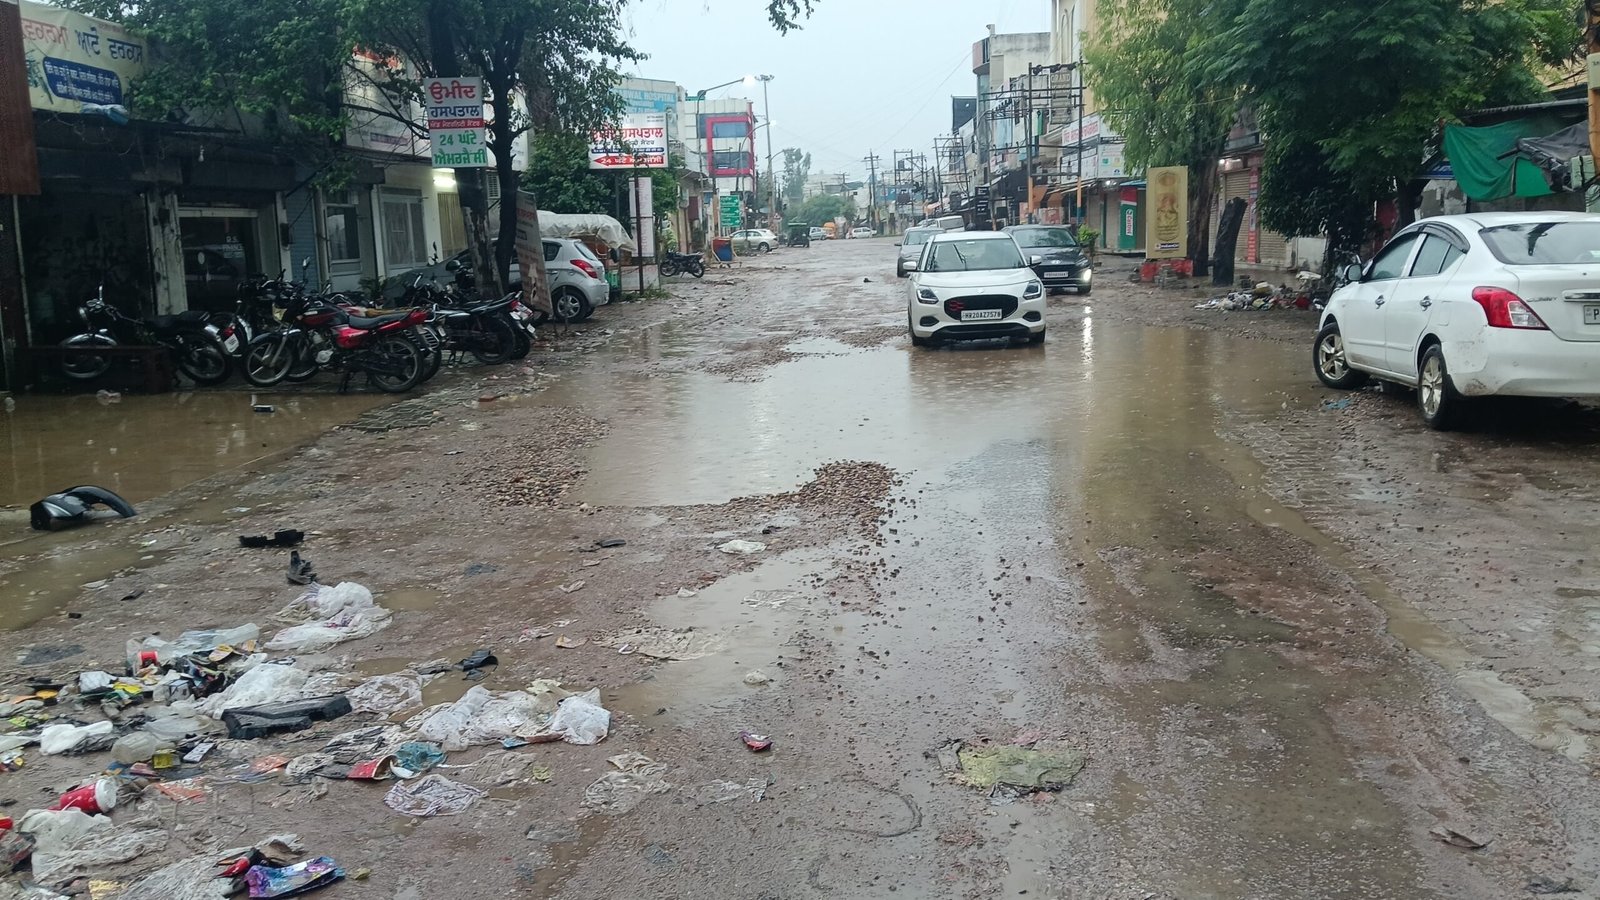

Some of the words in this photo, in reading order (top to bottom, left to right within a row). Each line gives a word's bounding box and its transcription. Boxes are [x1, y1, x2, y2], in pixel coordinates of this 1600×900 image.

[429, 80, 476, 104] ਉਮੀਦ
[429, 105, 480, 118] ਹਸਪਤਾਲ
[440, 134, 454, 146] 24
[458, 129, 477, 144] ਘੰਟੇ
